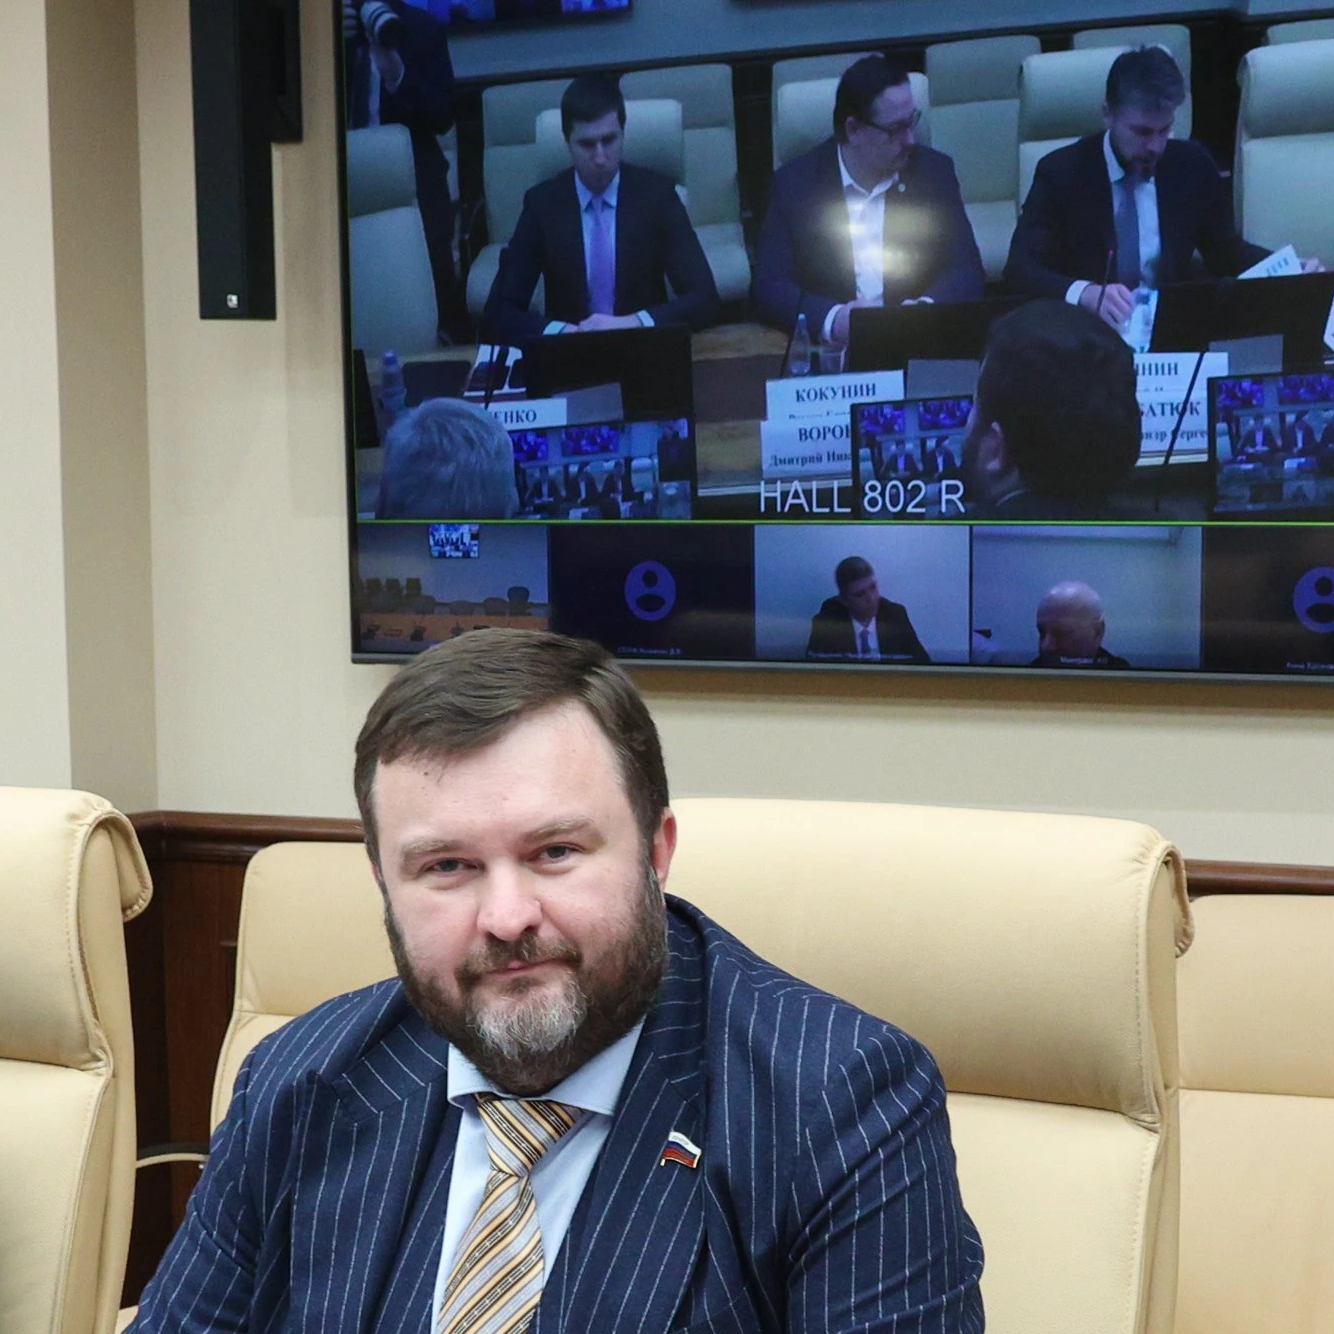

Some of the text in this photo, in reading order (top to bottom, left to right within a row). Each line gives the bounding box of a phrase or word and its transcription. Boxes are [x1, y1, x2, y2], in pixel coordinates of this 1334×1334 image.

[795, 382, 877, 403] КОКУНИН
[489, 408, 538, 424] ЕНКО
[759, 479, 966, 513] HALL 802 R
